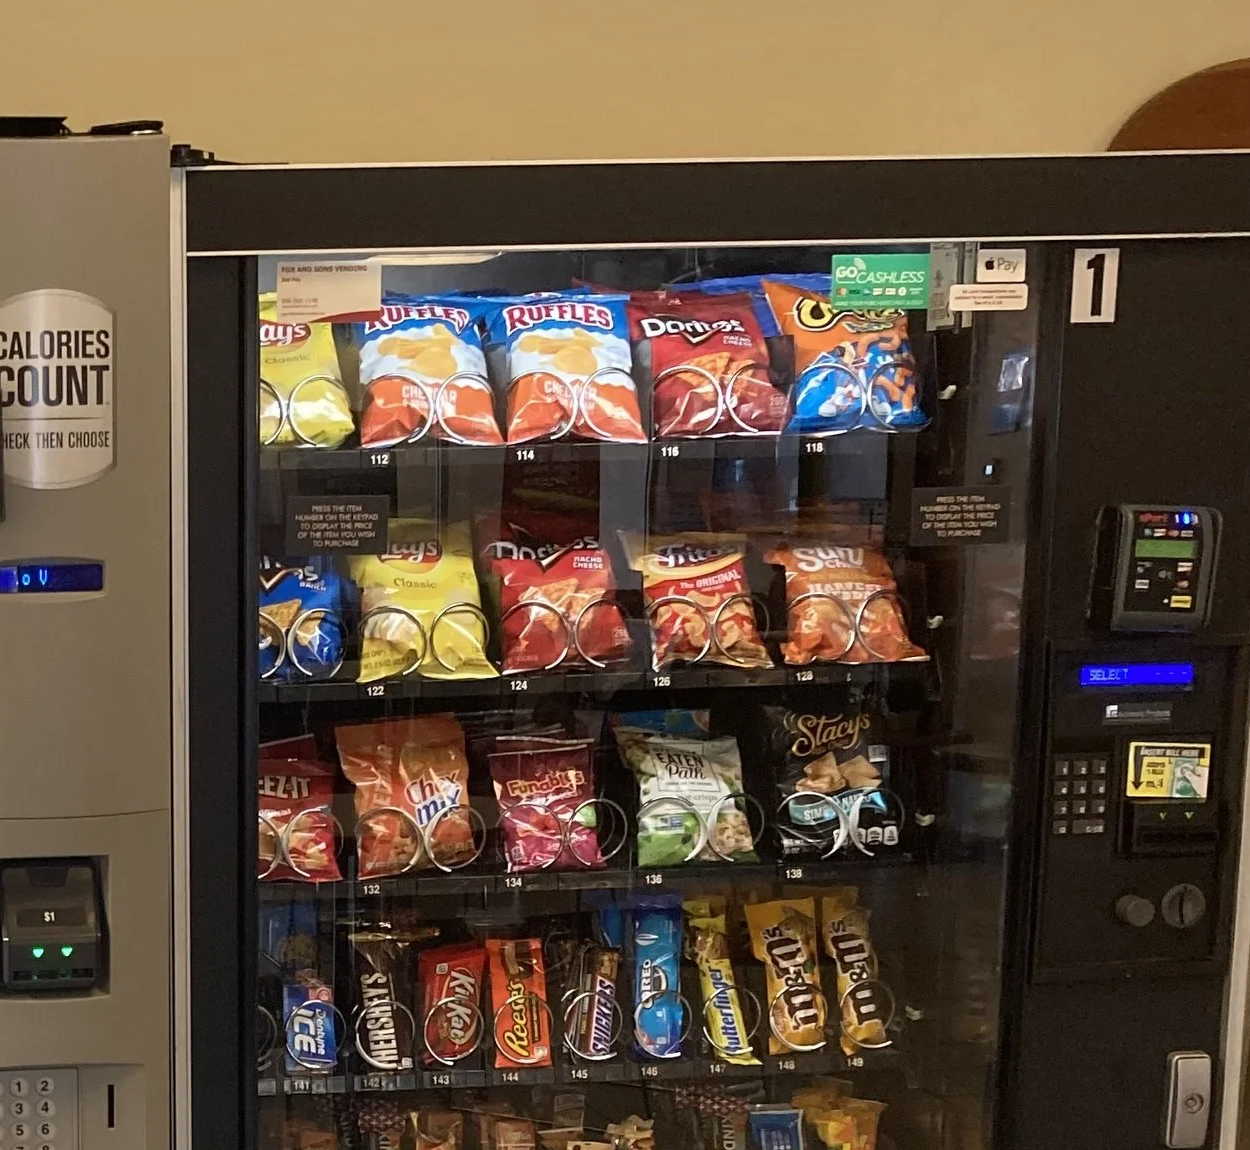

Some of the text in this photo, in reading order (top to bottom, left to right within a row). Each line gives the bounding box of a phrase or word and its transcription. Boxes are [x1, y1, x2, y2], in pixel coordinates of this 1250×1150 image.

[997, 257, 1018, 273] Pay
[836, 266, 858, 279] GO
[856, 271, 925, 284] CASHLESS
[1086, 253, 1105, 317] 1
[365, 304, 470, 335] RUFFLES
[502, 303, 614, 336] RUFFLES
[641, 318, 746, 338] Doritos
[264, 354, 311, 365] Classic
[2, 431, 110, 450] HECK THEN CHOOSE
[661, 446, 679, 456] 116
[805, 443, 824, 453] 118
[370, 454, 389, 465] 112
[516, 450, 535, 461] 114
[394, 577, 437, 589] Classic
[796, 671, 813, 681] 128
[1089, 668, 1128, 681] SELECT
[510, 681, 528, 691] 124
[653, 676, 671, 687] 126
[366, 685, 385, 697] 122
[655, 751, 704, 767] EATEN
[665, 764, 706, 780] Path
[505, 878, 522, 888] 134
[645, 875, 662, 885] 136
[363, 885, 380, 894] 132
[44, 911, 55, 922] $1
[642, 959, 652, 1009] OREO
[591, 976, 615, 1053] SNICKERS
[709, 967, 742, 1053] Butterfinger
[361, 972, 399, 1064] HERSHEY'S
[503, 980, 530, 1057] Reese's
[293, 1006, 318, 1055] ICE
[315, 1009, 326, 1055] Dentyne
[847, 1058, 863, 1067] 149
[641, 1067, 658, 1076] 146
[710, 1064, 726, 1073] 147
[502, 1073, 518, 1082] 144
[571, 1070, 588, 1079] 145
[293, 1081, 310, 1091] 141
[362, 1078, 379, 1088] 142
[432, 1076, 450, 1085] 143
[15, 1082, 21, 1092] 1
[41, 1081, 49, 1092] 2
[16, 1103, 23, 1114] 3
[41, 1102, 49, 1113] 4
[16, 1125, 24, 1136] 5
[42, 1124, 49, 1134] 6
[723, 1114, 736, 1150] KIND
